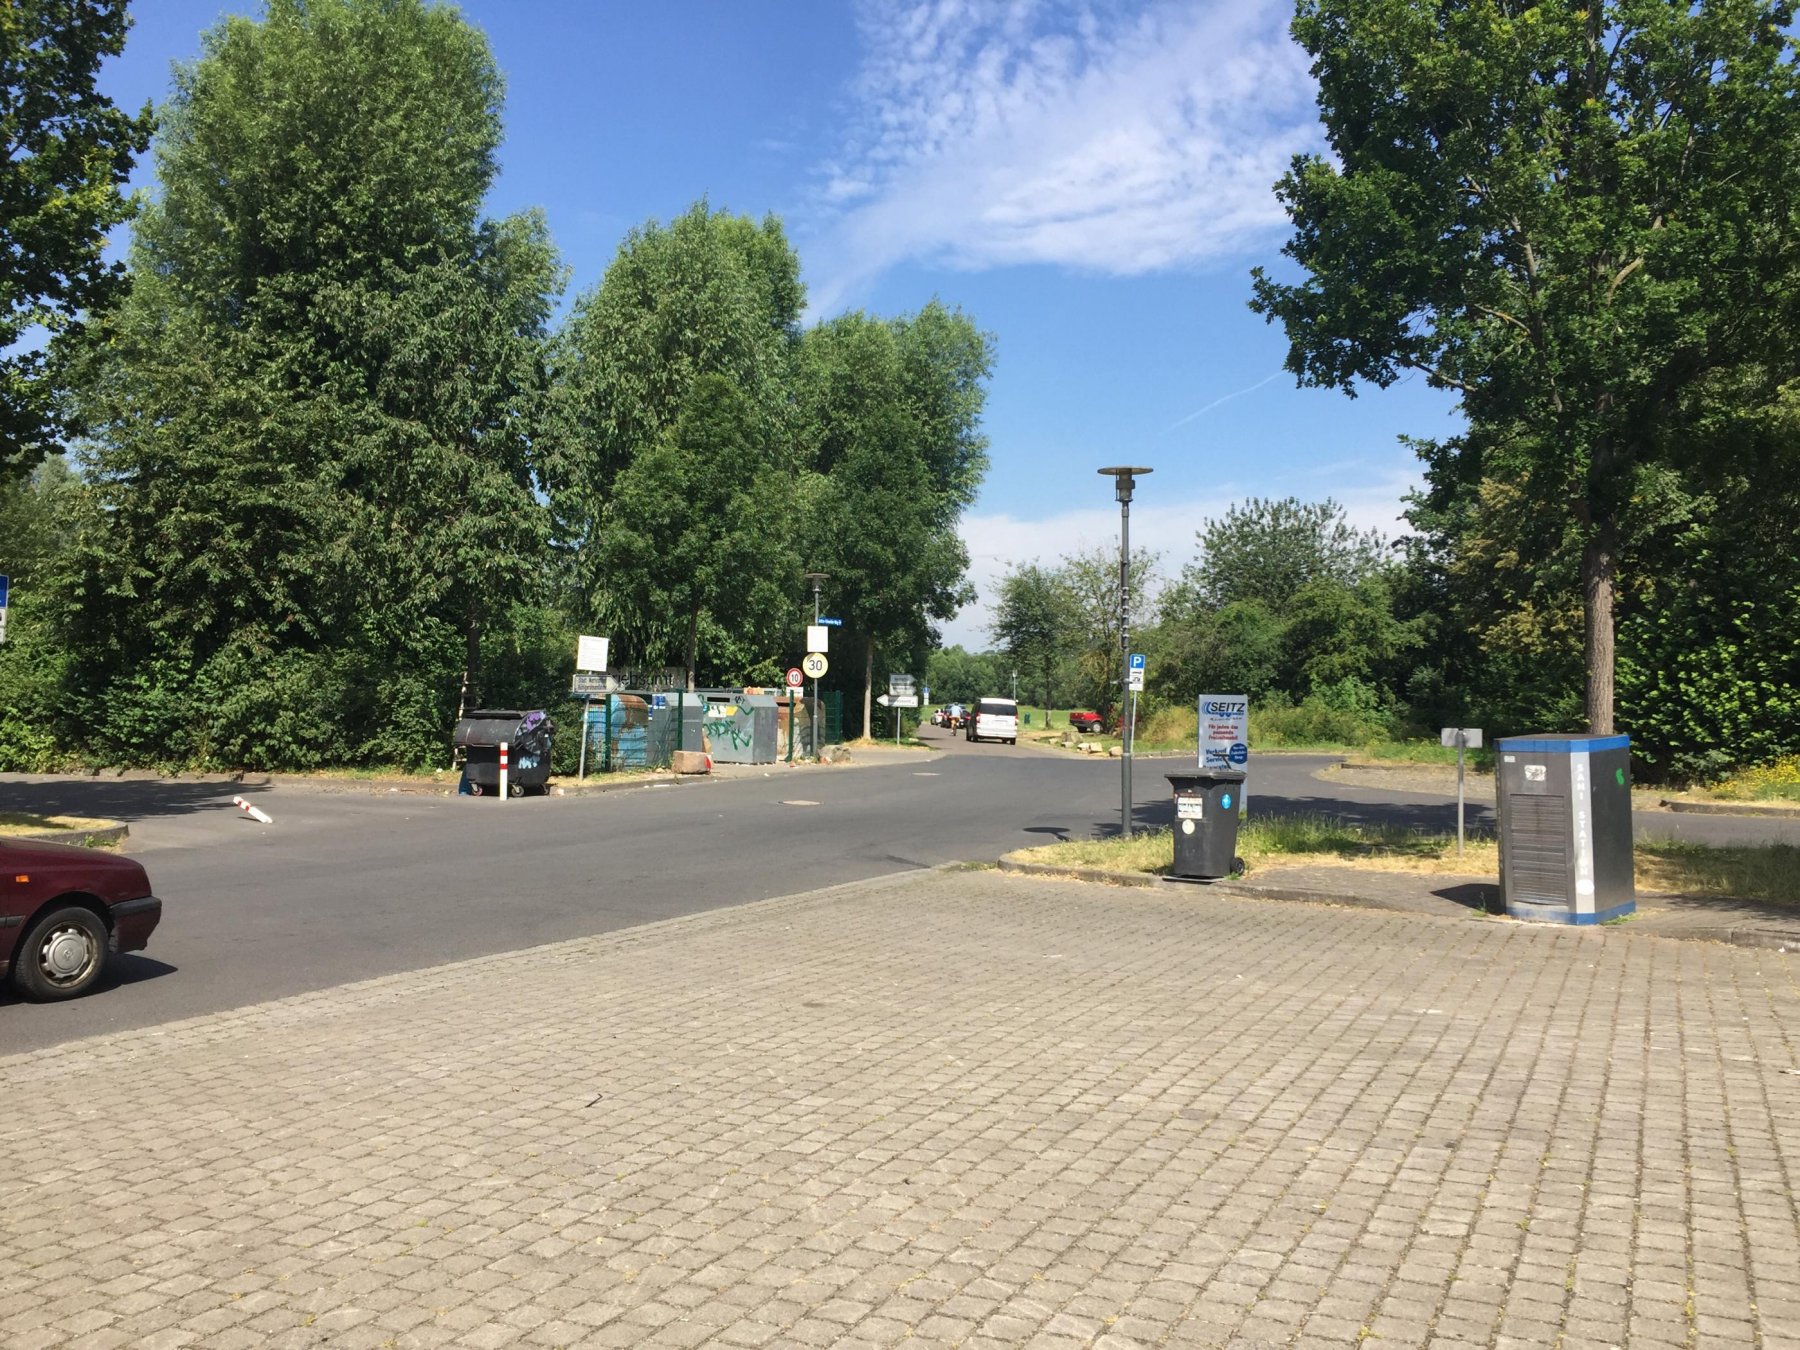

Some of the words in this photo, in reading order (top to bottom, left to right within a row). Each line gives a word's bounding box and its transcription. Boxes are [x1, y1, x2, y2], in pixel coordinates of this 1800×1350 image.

[809, 660, 823, 671] 30
[1133, 656, 1142, 667] P
[791, 673, 799, 683] 10
[1210, 702, 1246, 712] SEITZ
[1576, 763, 1586, 800] SANI
[1578, 811, 1588, 876] STATION
